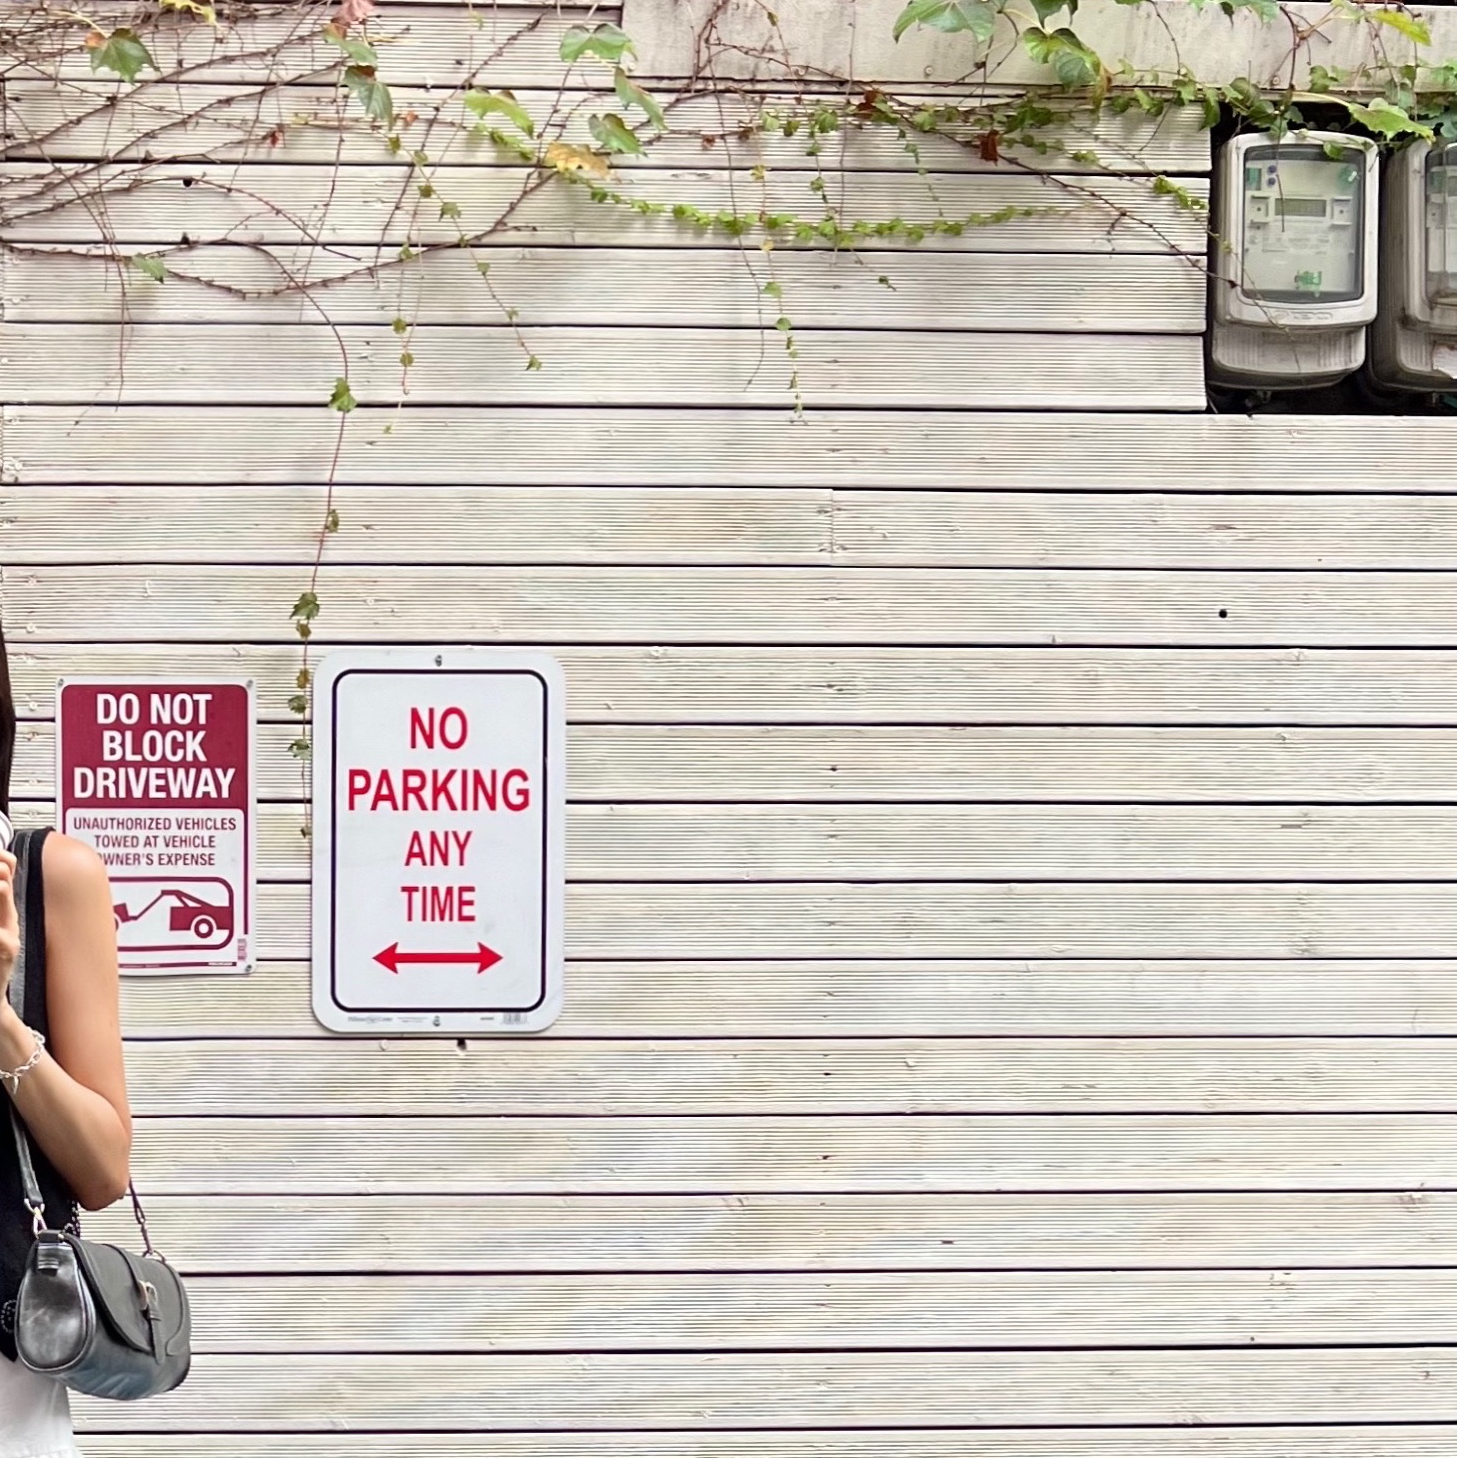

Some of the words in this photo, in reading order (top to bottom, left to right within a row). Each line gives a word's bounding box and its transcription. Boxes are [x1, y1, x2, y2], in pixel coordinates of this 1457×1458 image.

[96, 693, 140, 725] DO
[150, 693, 213, 726] NOT
[410, 706, 468, 750] NO
[102, 729, 207, 763] BLOCK
[73, 766, 236, 799] DRIVEWAY
[348, 768, 531, 812] PARKING
[73, 816, 172, 831] UNAUTHORIZED
[175, 817, 237, 831] VEHICLES
[94, 834, 139, 848] TOWED
[143, 835, 158, 848] AT
[164, 835, 216, 848] VEHICLE
[404, 830, 473, 867] ANY
[158, 853, 216, 867] EXPENSE
[400, 886, 476, 922] TIME
